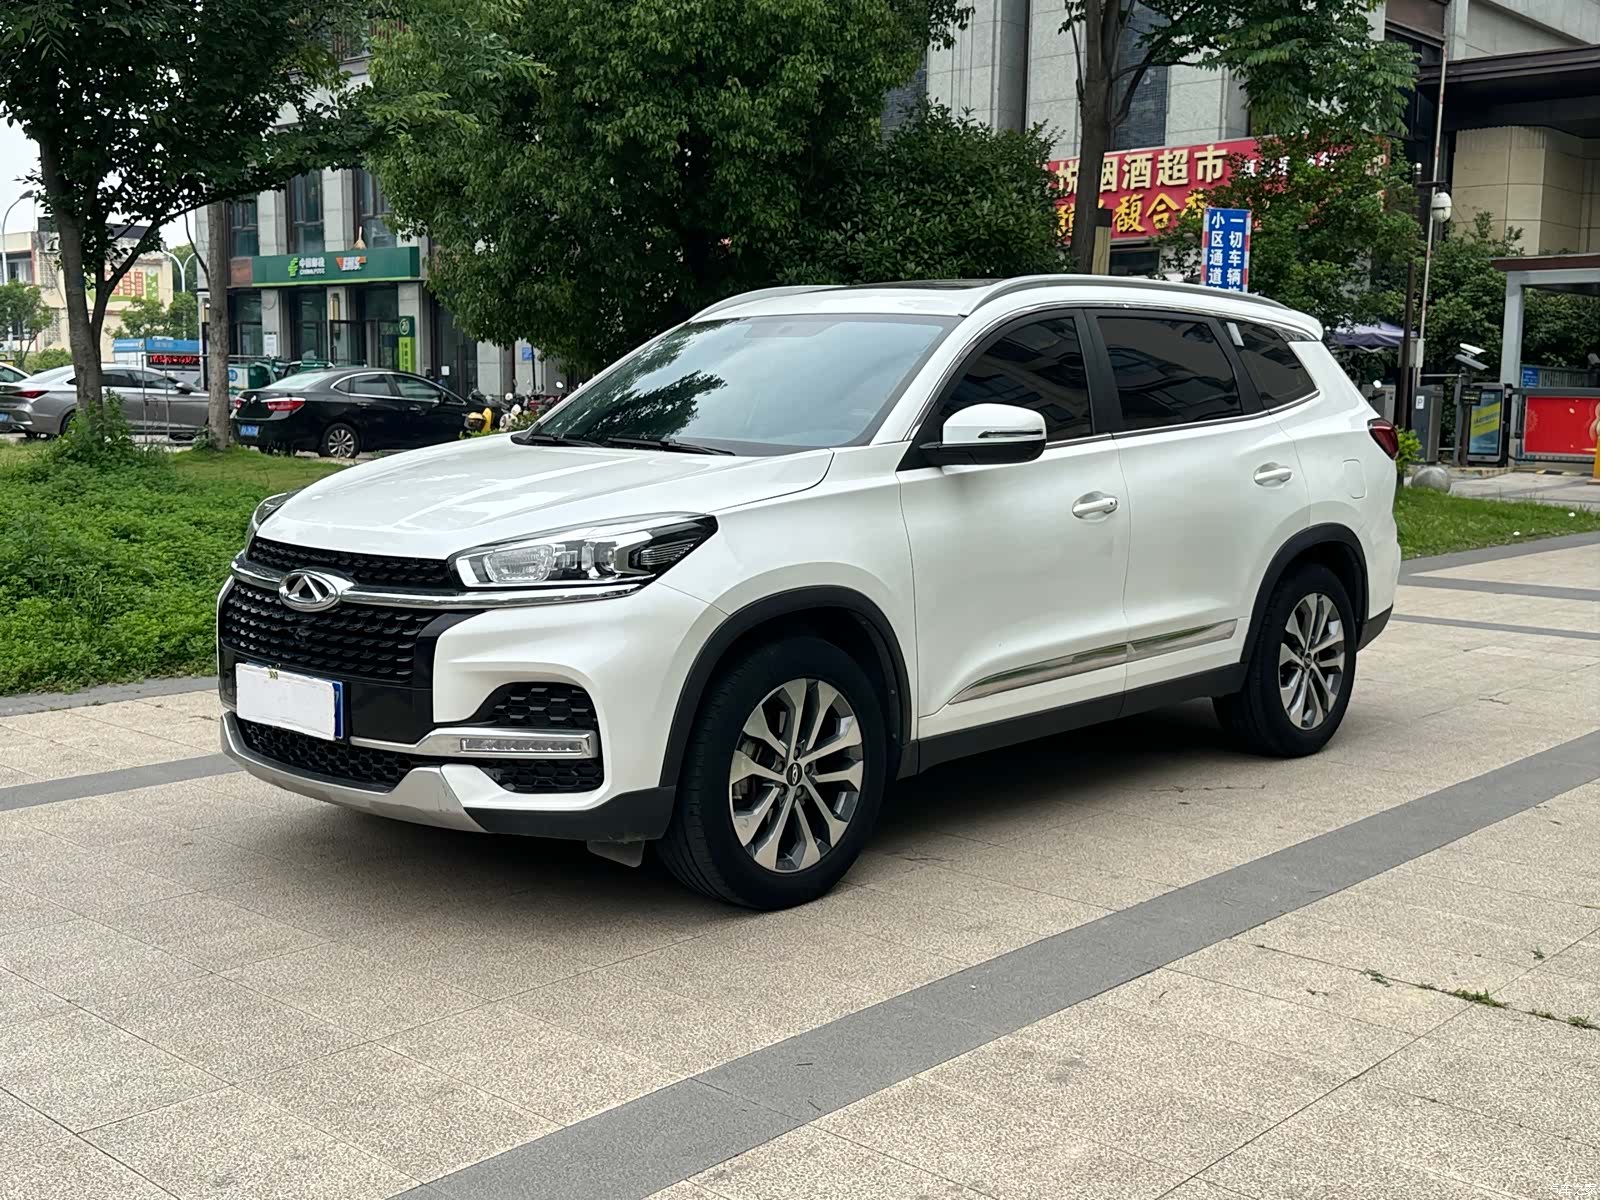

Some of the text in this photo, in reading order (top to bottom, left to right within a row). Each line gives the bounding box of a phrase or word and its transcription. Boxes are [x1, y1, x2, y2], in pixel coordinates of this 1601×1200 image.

[1208, 211, 1225, 289] 小区通道
[1226, 218, 1244, 291] 一切车辆
